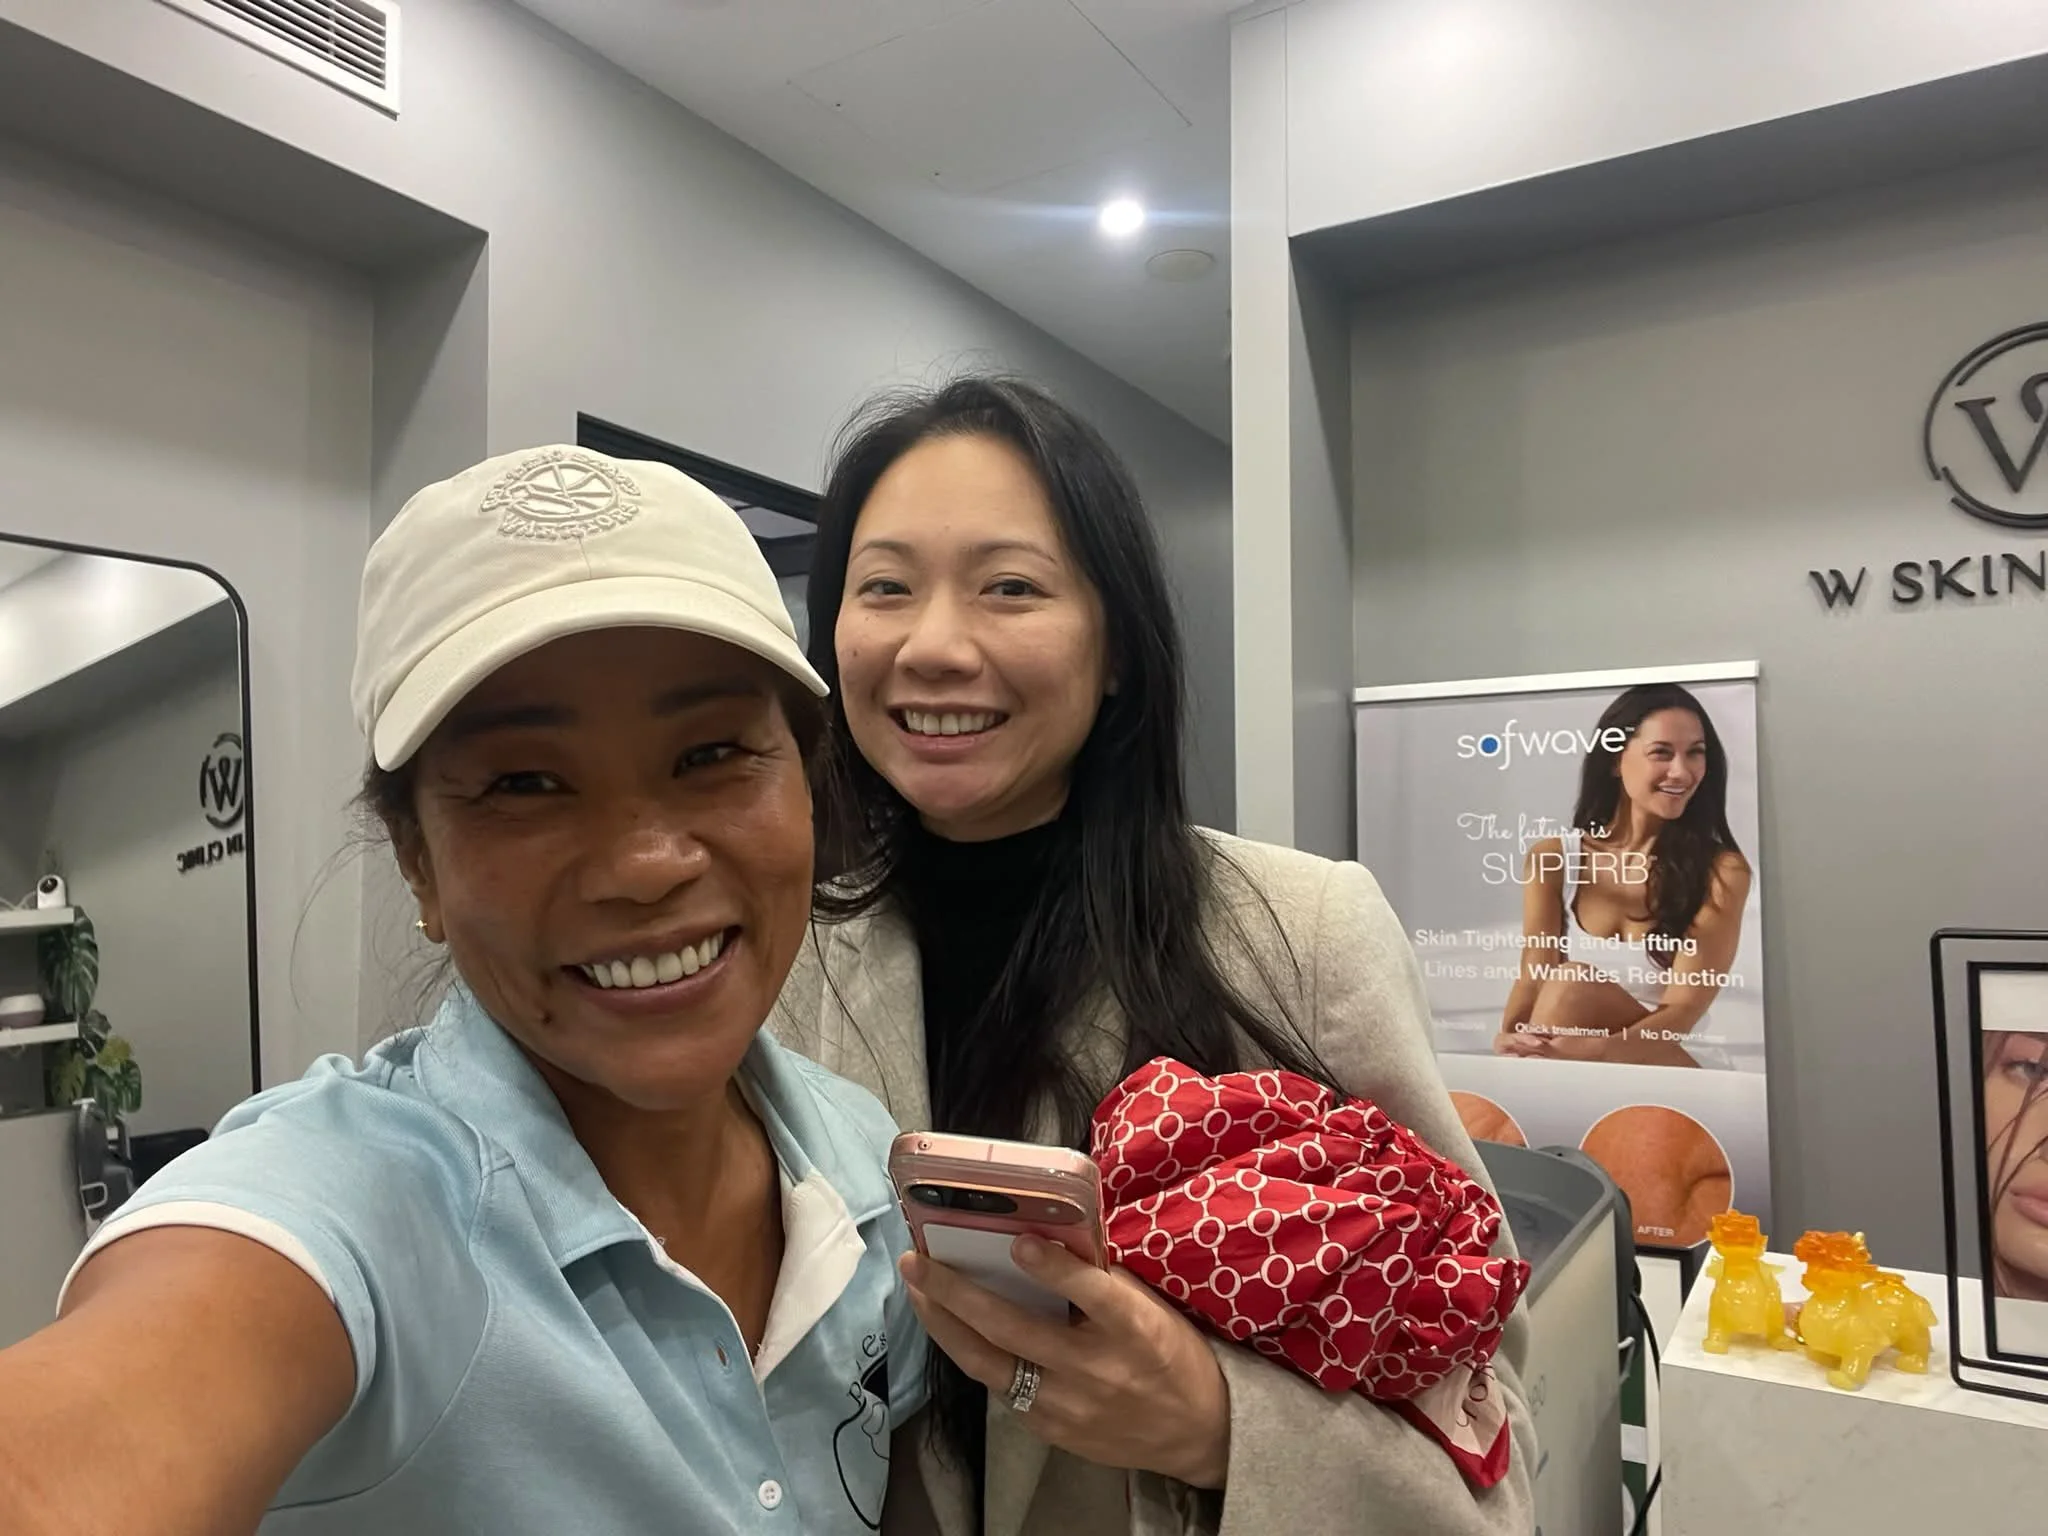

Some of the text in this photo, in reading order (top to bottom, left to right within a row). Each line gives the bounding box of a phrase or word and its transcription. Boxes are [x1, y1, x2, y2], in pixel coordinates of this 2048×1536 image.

[1808, 550, 2045, 608] W SKIN
[1456, 812, 1612, 855] The future is
[1481, 852, 1649, 884] SUPERB
[1414, 929, 1698, 956] Skin Tightening and Lifting
[1424, 960, 1745, 988] Lines and Wrinkles Reduction
[1515, 1021, 1550, 1035] Quick
[1552, 1024, 1610, 1038] treatment
[1640, 1028, 1658, 1041] No
[1637, 1225, 1675, 1238] AFTER
